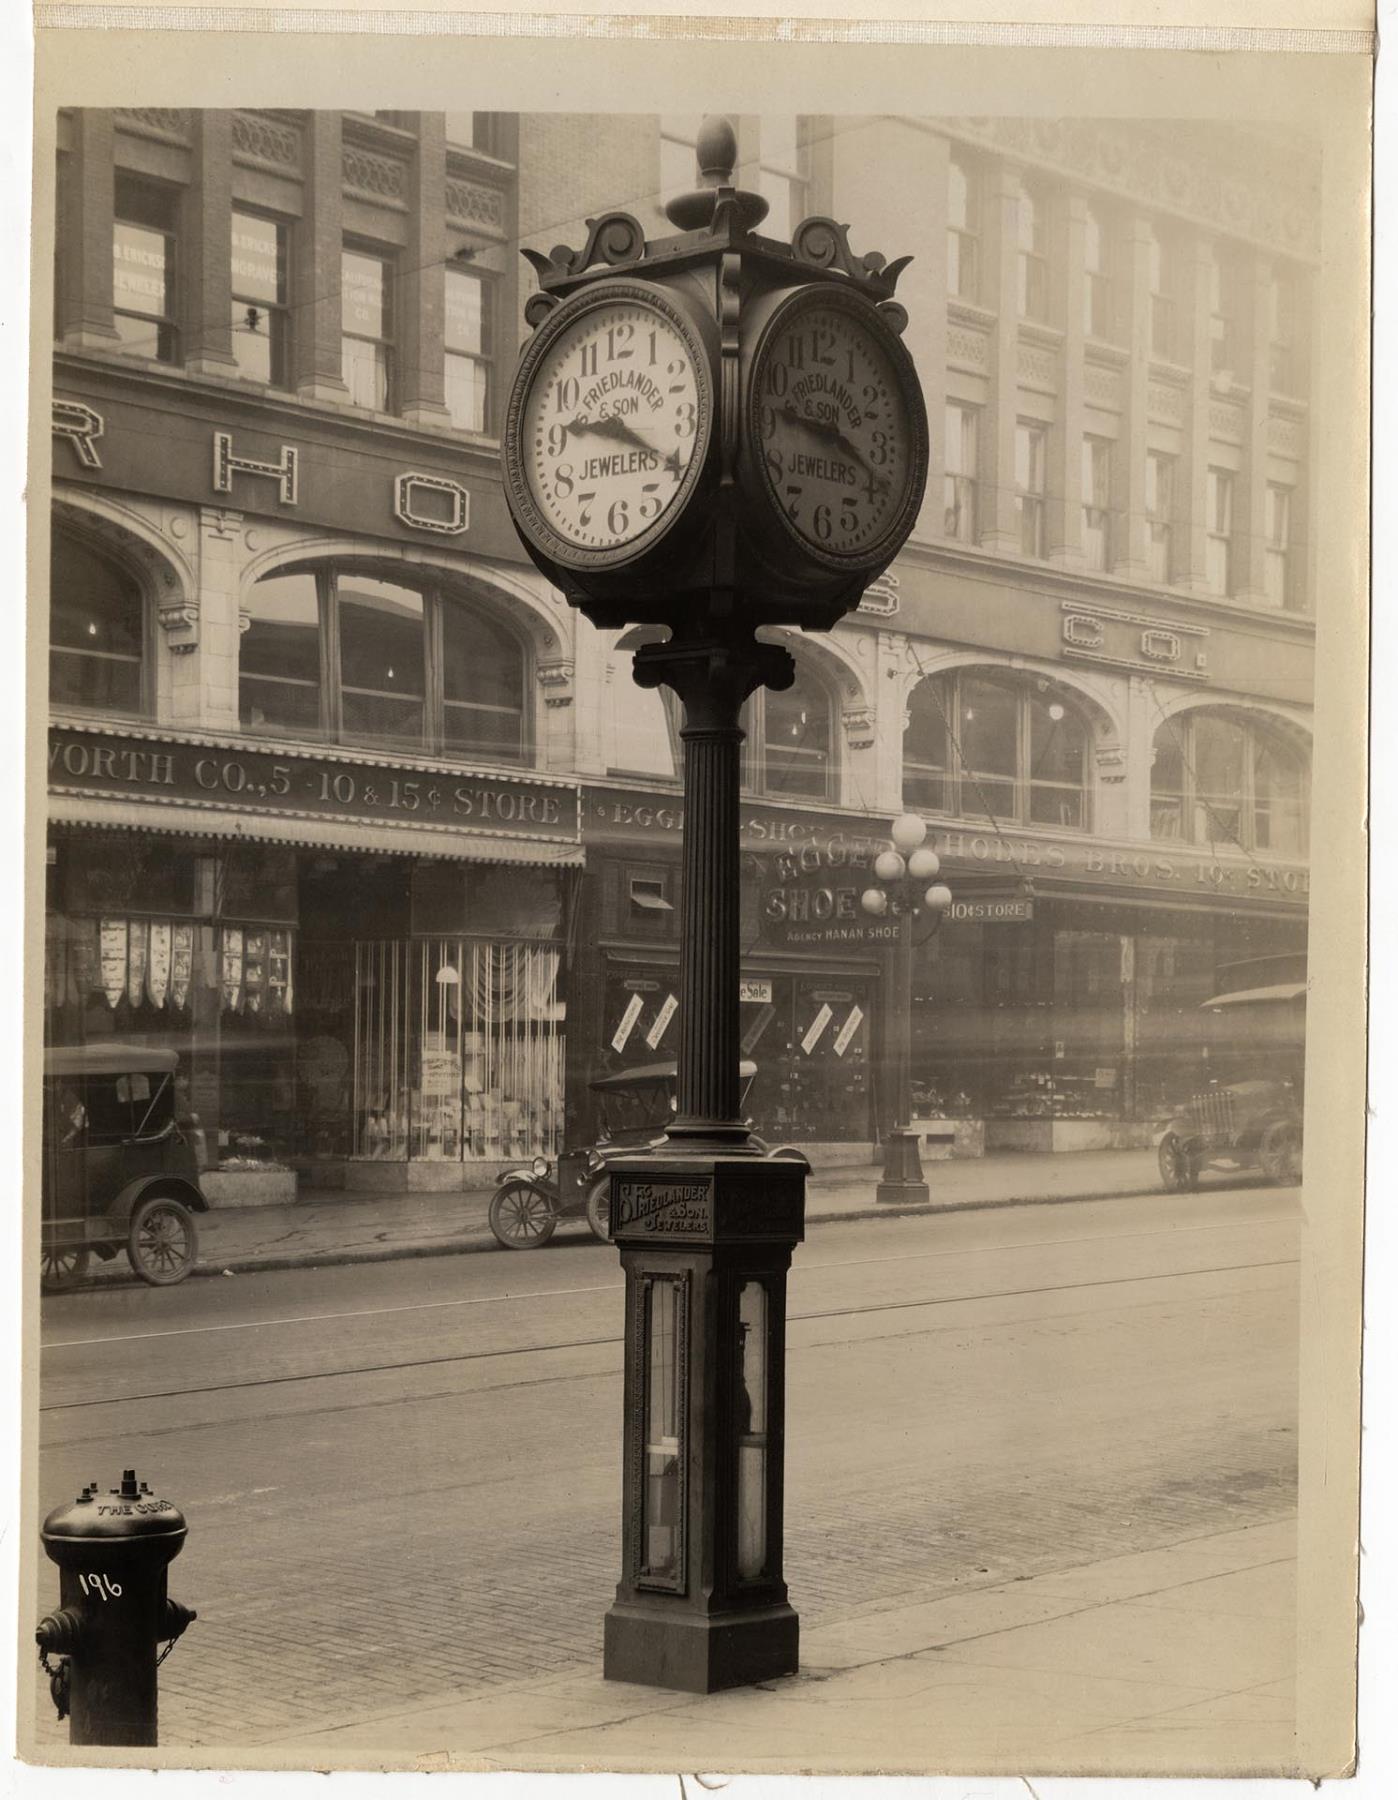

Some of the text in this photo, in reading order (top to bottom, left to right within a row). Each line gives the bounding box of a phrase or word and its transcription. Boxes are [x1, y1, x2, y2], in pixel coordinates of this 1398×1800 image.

[606, 324, 635, 361] 12
[648, 331, 657, 366] 1
[787, 335, 804, 370] 11
[811, 331, 837, 366] 12
[580, 344, 598, 378] 11
[667, 359, 686, 394] 2
[556, 376, 581, 414] 10
[583, 369, 665, 413] FRIEDLANDER
[599, 395, 639, 420] & SON
[788, 373, 862, 430] FRIEDLANDER
[674, 403, 695, 438] 3
[817, 402, 840, 427] SON
[548, 423, 567, 457] 9
[554, 463, 575, 499] 8
[579, 449, 659, 481] JEWELERS
[787, 452, 857, 487] JEWELERS
[578, 492, 597, 528] 7
[607, 500, 629, 536] 6
[639, 483, 663, 519] 5
[813, 504, 833, 541] 6
[363, 786, 381, 806] &
[454, 787, 561, 825] STORE
[611, 803, 824, 842] EGG SHO
[775, 833, 900, 882] EGGER
[938, 833, 1067, 868] HODES
[1247, 866, 1310, 893] STO
[766, 887, 857, 921] SHOE
[976, 903, 1025, 917] STORE
[826, 927, 864, 939] HANAN
[867, 926, 900, 939] SHOE
[747, 982, 767, 999] Sale
[98, 1505, 134, 1516] THE
